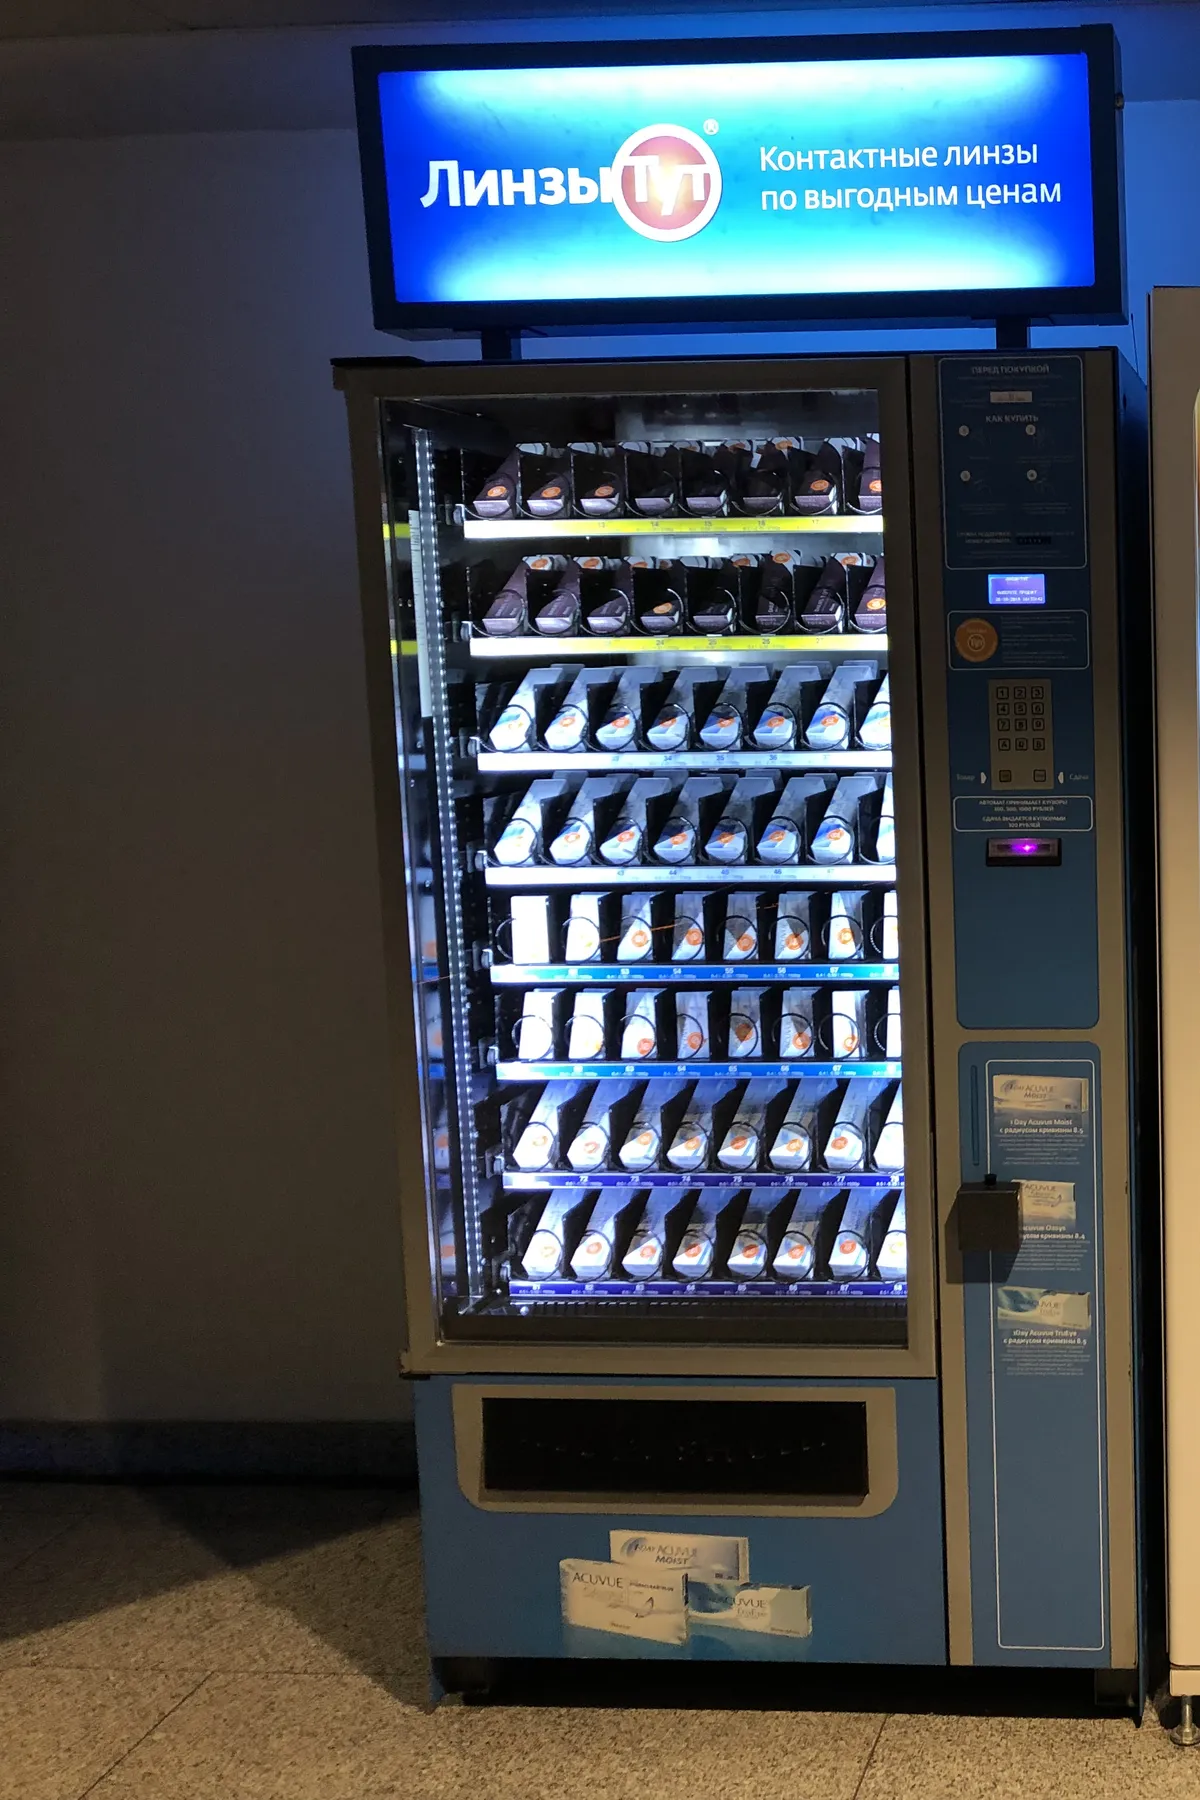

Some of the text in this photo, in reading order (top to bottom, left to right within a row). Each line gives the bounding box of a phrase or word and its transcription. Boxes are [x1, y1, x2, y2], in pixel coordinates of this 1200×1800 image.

[760, 144, 1038, 171] Контактные линзы
[762, 183, 1061, 212] по выгодным ценам
[1014, 1119, 1027, 1127] Day
[572, 1572, 623, 1589] ACUVUE
